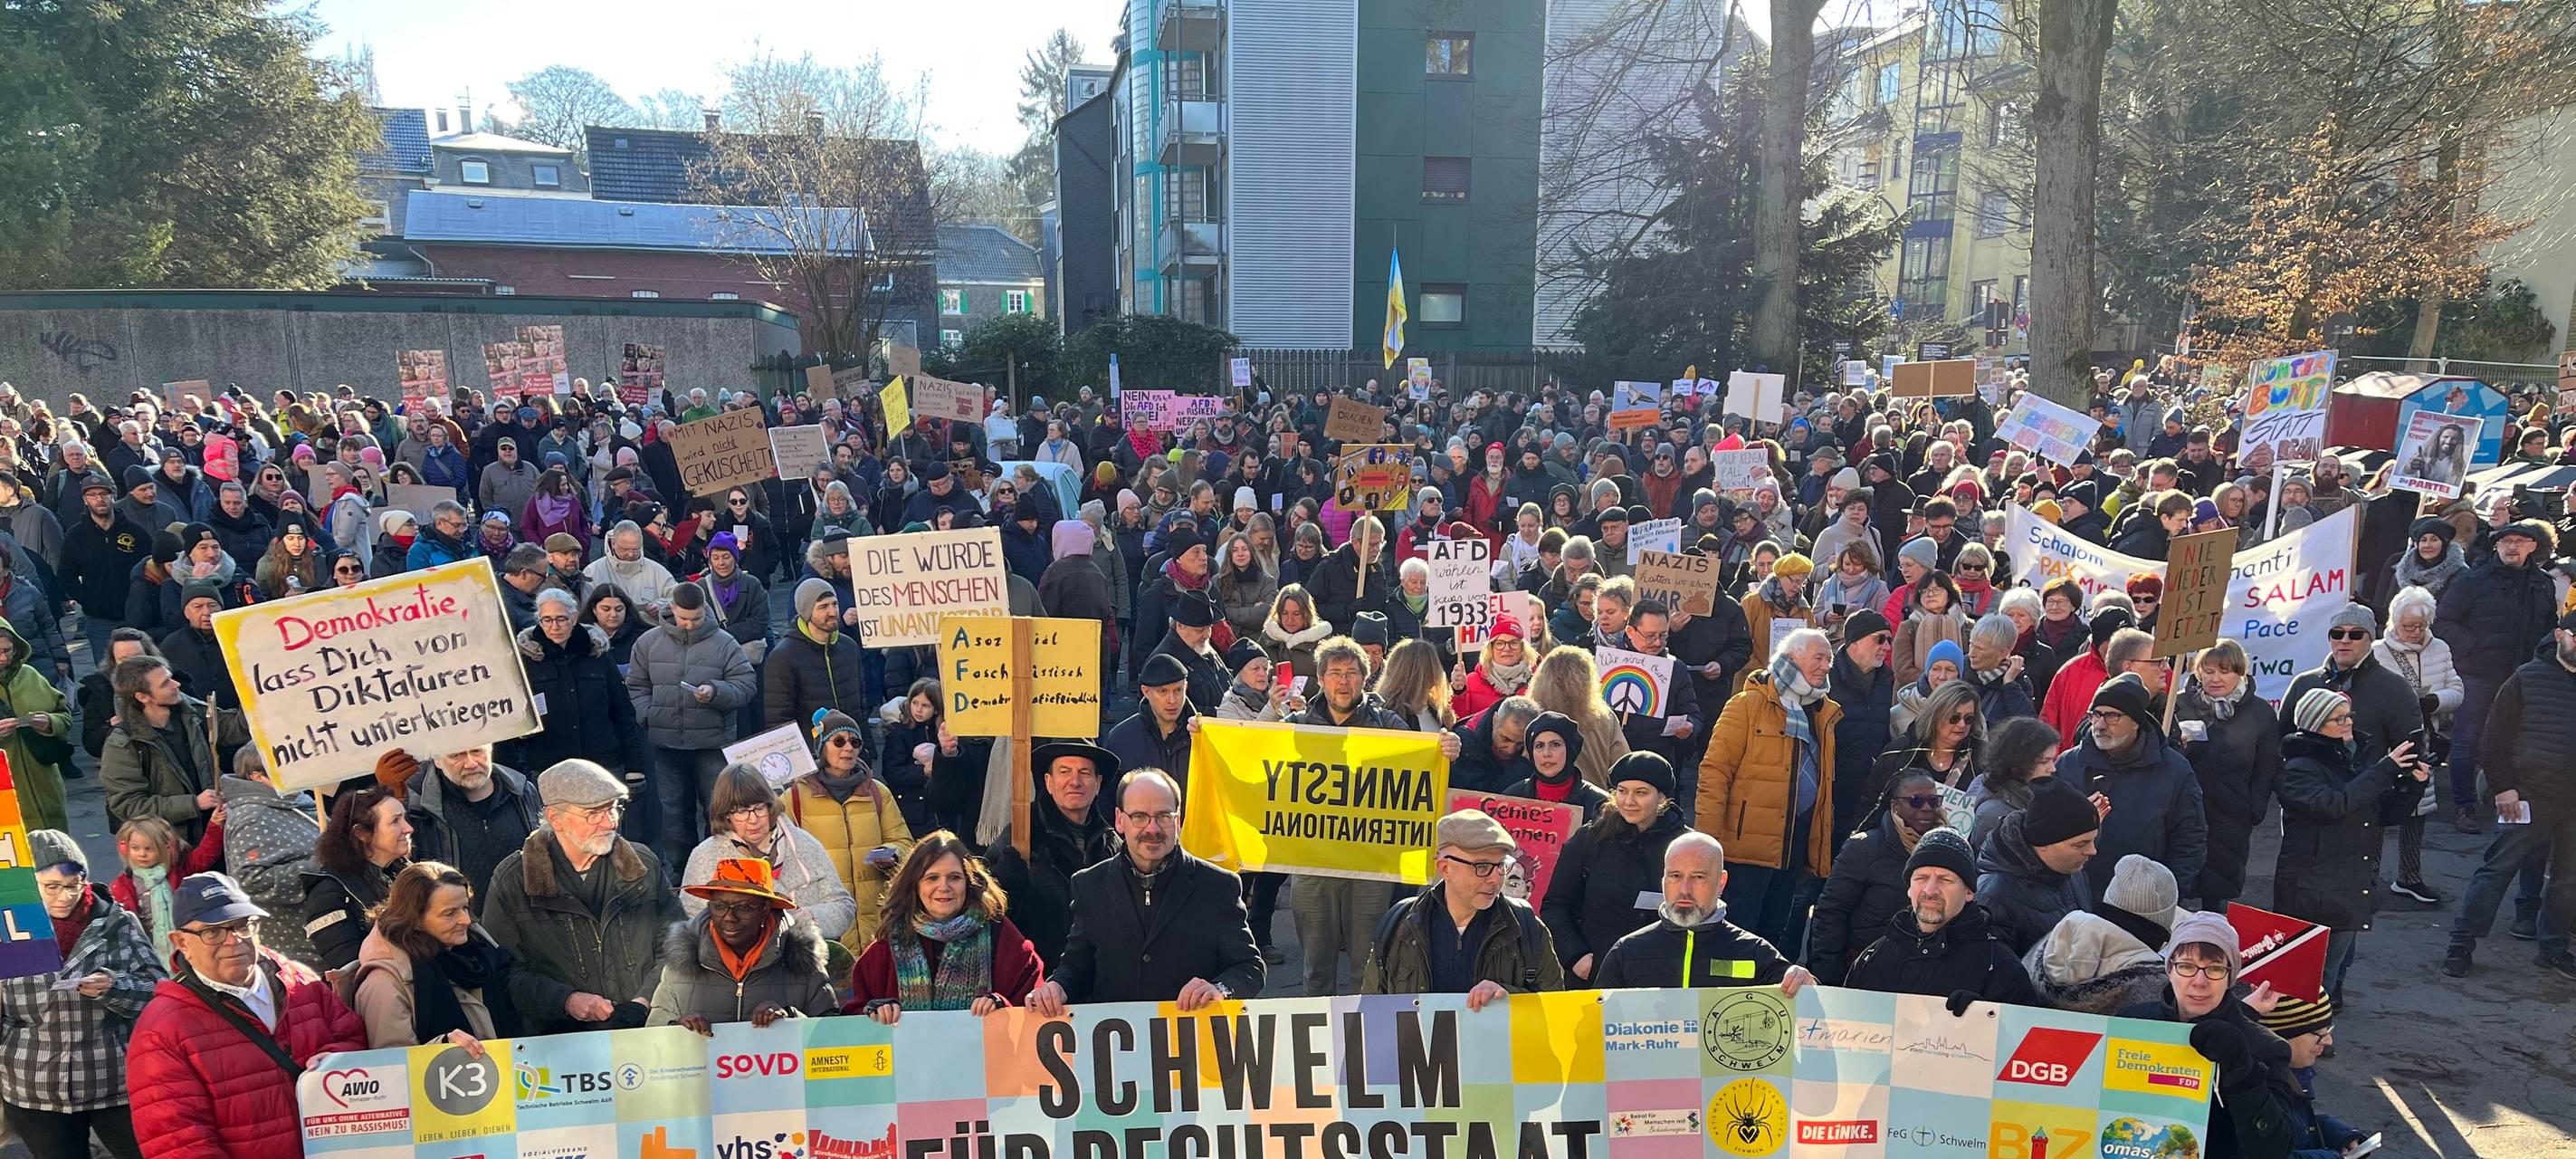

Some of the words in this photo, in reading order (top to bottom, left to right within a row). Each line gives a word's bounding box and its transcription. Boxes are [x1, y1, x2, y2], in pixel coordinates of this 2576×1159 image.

[920, 380, 951, 393] NAZIS
[1123, 391, 1150, 401] NEIN
[2247, 377, 2327, 416] BUNT
[1137, 401, 1154, 411] AFD
[1156, 403, 1168, 412] ist
[1187, 407, 1216, 416] RISIKEN
[674, 425, 696, 441] MIT
[704, 412, 754, 437] NAZIS
[1338, 410, 1374, 426] DRACHEN
[2245, 412, 2324, 444] STATT
[683, 445, 705, 461] wird
[712, 438, 736, 453] nicht
[683, 447, 774, 487] GEKUSCHELT!
[2409, 478, 2450, 494] PARTEI
[1434, 541, 1488, 560] AFD
[2029, 526, 2104, 567] Schalom
[2183, 541, 2214, 565] NIE
[867, 548, 903, 575] DIE
[913, 541, 996, 571] WÜRDE
[1643, 553, 1709, 573] NAZIS
[2039, 556, 2077, 580] PAX
[1435, 564, 1484, 579] wählen
[1639, 570, 1672, 586] hatten
[2166, 565, 2216, 593] WIEDER
[858, 588, 892, 606] DES
[892, 577, 999, 607] MENSCHEN
[1449, 580, 1467, 590] ist
[2244, 568, 2345, 608] SALAM
[1640, 588, 1682, 612] WAR
[2174, 590, 2205, 615] IST
[274, 583, 468, 651] Demokratie,
[1437, 601, 1488, 626] 1933
[860, 620, 879, 638] IST
[2245, 618, 2299, 639] Pace
[253, 664, 316, 694] lass
[316, 638, 393, 676] Dich
[414, 631, 468, 656] von
[1599, 652, 1620, 666] Wir
[1623, 656, 1646, 667] sind
[307, 662, 491, 713] Diktaturen
[272, 721, 341, 767] nicht
[350, 695, 514, 748] unterkriegen
[1480, 798, 1553, 824] Genies
[1605, 1021, 1680, 1037] Diakonie
[1606, 1039, 1680, 1051] Mark-Ruhr
[2118, 1049, 2151, 1060] Freie
[811, 1055, 850, 1066] AMNESTY
[1035, 1011, 1462, 1118] SCHWELM
[1709, 1045, 1786, 1069] SCHWELM
[811, 1066, 850, 1074] INTERNATIONAL
[2011, 1060, 2068, 1082] DGB
[2116, 1059, 2202, 1078] Demokraten
[341, 1080, 380, 1097] AWO
[438, 1063, 487, 1100] K3
[560, 1071, 612, 1094] TBS
[2179, 1078, 2199, 1087] FDP
[517, 1102, 549, 1111] Technische
[306, 1116, 320, 1125] FÜR
[322, 1116, 337, 1124] UNS
[339, 1114, 358, 1123] OHNE
[361, 1110, 406, 1121] ALTERNATIVE:
[307, 1127, 330, 1138] NEIN
[335, 1125, 348, 1135] ZU
[351, 1120, 407, 1133] RASSISMUS!
[419, 1133, 444, 1143] LEBEN
[450, 1128, 476, 1139] LIEBEN
[483, 1125, 510, 1135] DIENEN
[1802, 1125, 1825, 1140] DIE
[1887, 1128, 1907, 1139] FeG
[1940, 1134, 1987, 1150] Schwelm
[522, 1146, 587, 1157] SOZIALVERBAND
[717, 1136, 771, 1159] vhs
